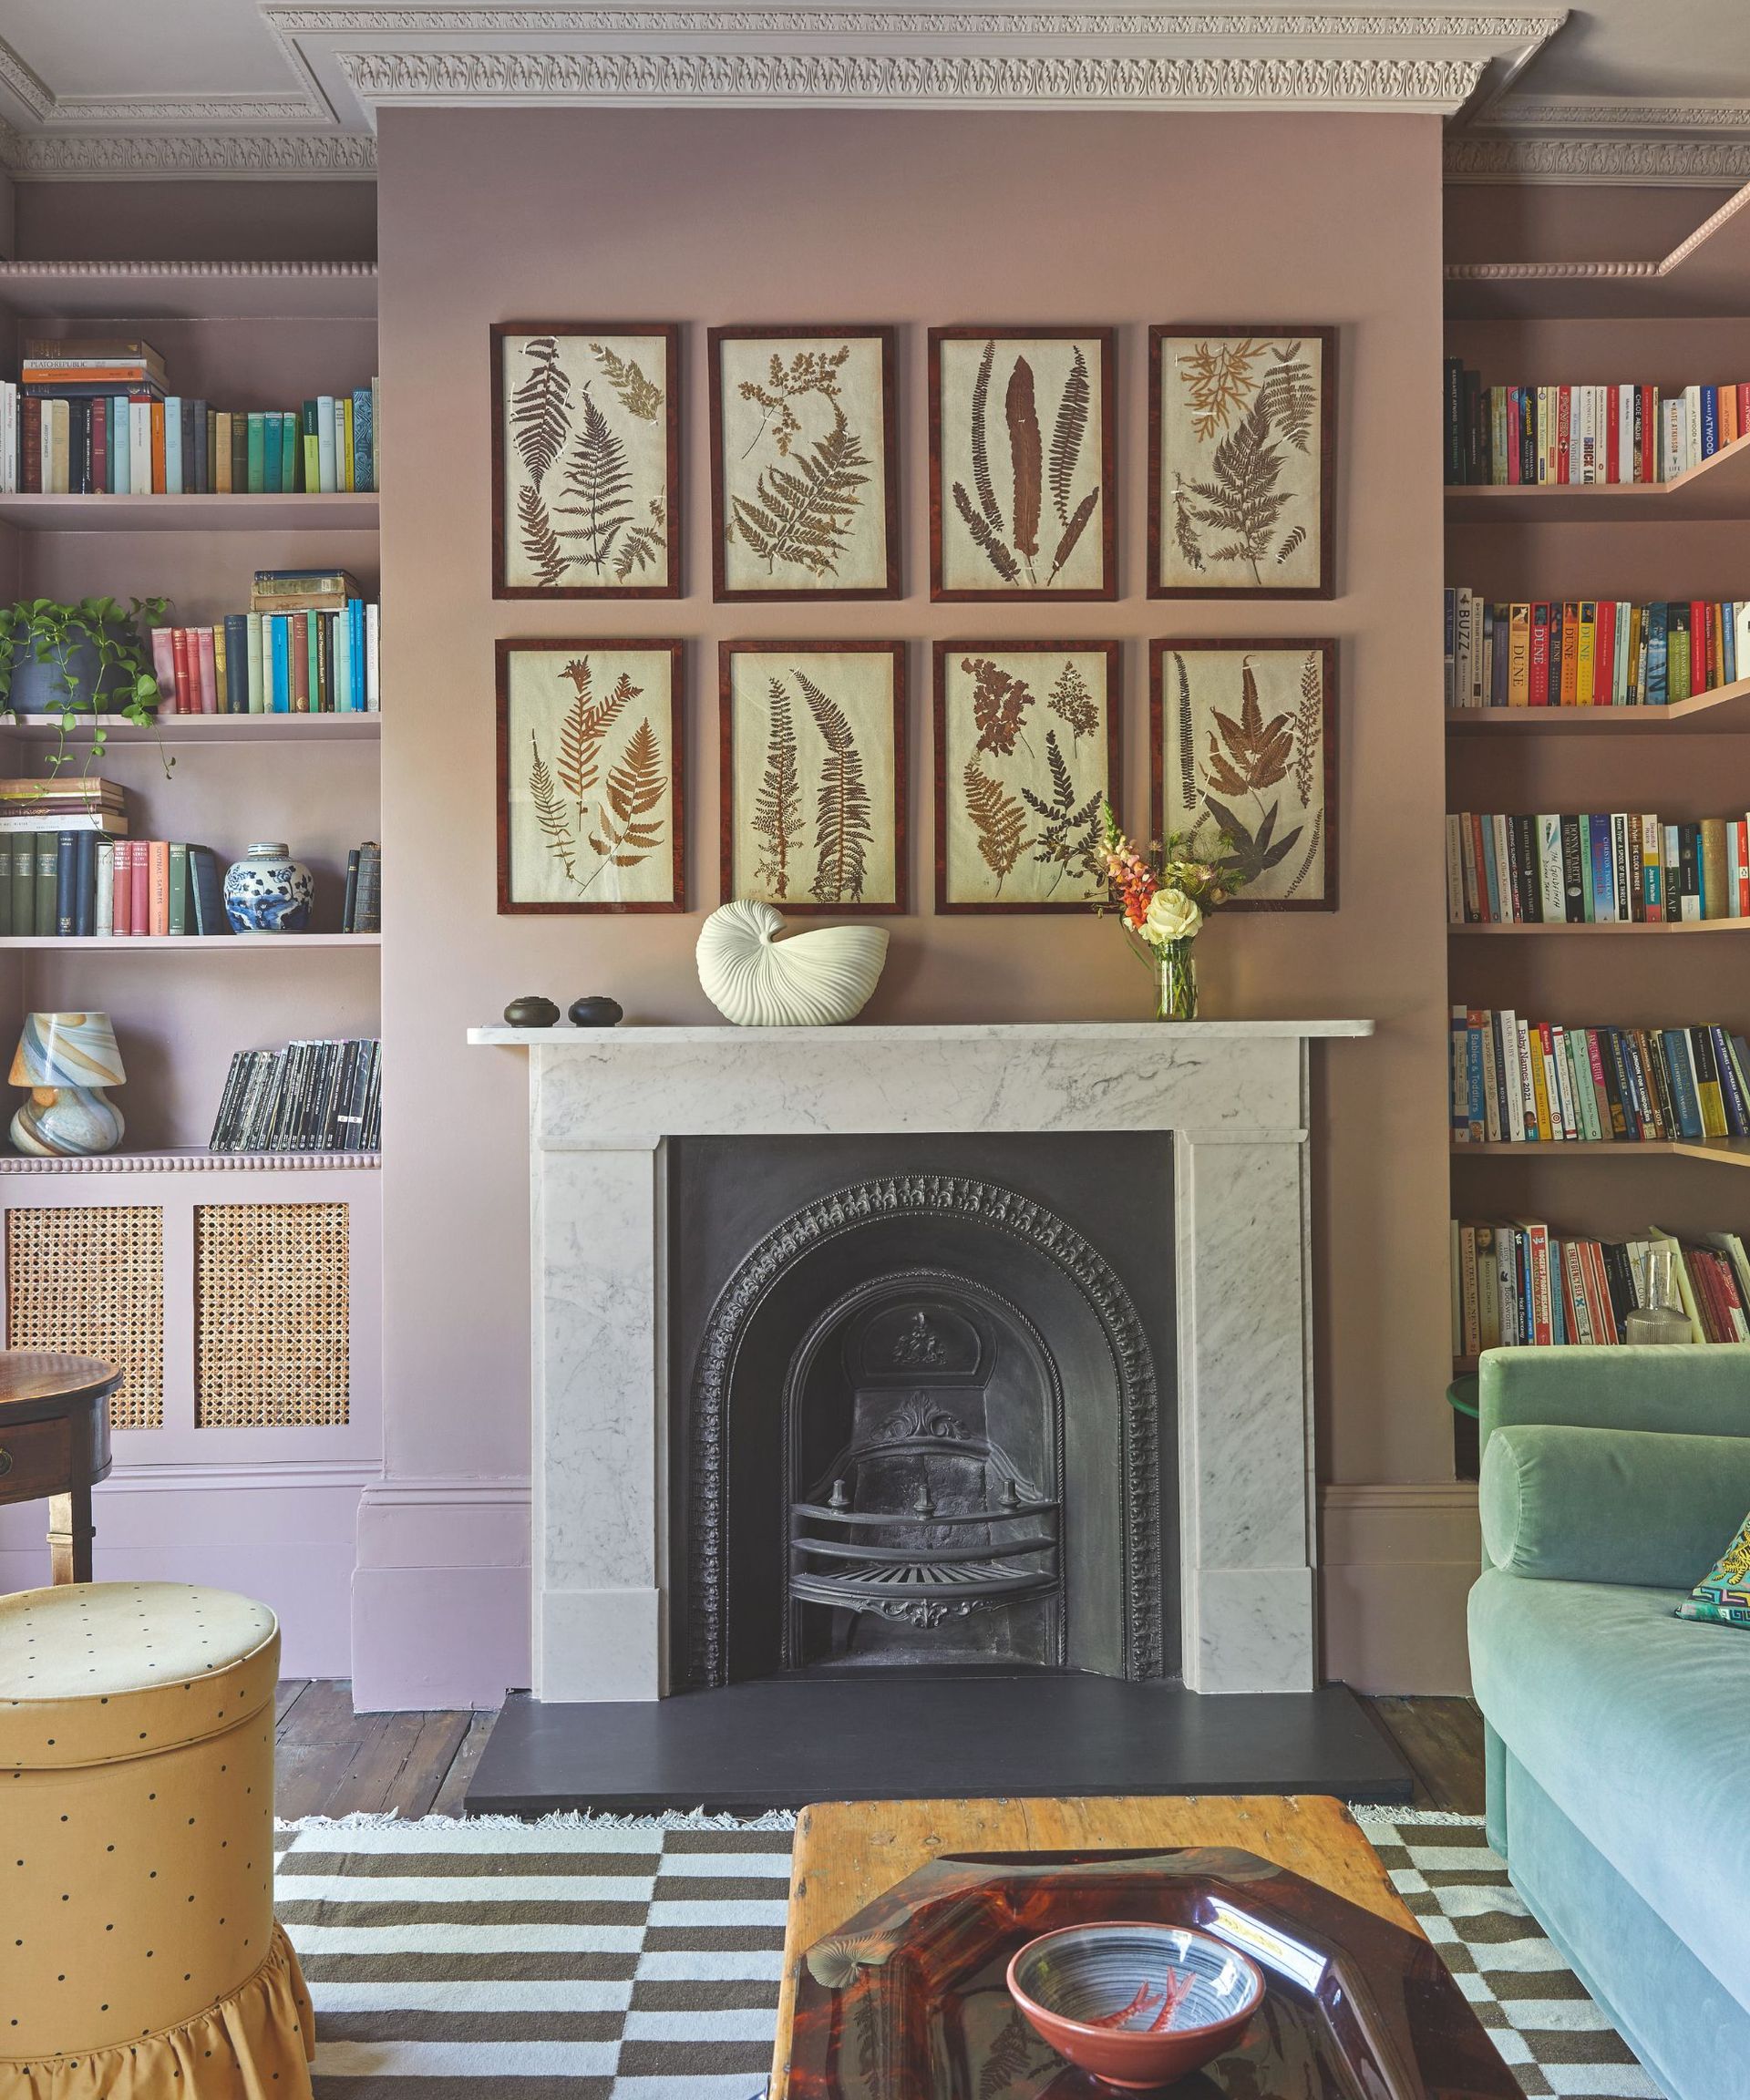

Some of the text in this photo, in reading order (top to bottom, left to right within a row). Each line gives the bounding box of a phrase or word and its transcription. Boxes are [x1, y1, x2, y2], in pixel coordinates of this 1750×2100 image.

[1584, 438, 1594, 467] BRICK
[1458, 610, 1470, 651] BUZZ
[1534, 629, 1544, 664] DUNE
[1564, 628, 1574, 660] DUNE
[1580, 626, 1590, 661] DUNE
[1513, 645, 1525, 687] DUNE
[1570, 823, 1581, 882] DONNA TARTT
[1668, 885, 1677, 912] SLAP
[1471, 1034, 1480, 1063] Babies
[1518, 1029, 1531, 1101] Baby Names 2021
[1632, 1052, 1642, 1075] LONDON
[1472, 1076, 1481, 1113] Toddlers
[1504, 1287, 1512, 1330] Bookworm
[1574, 1285, 1583, 1298] SEX
